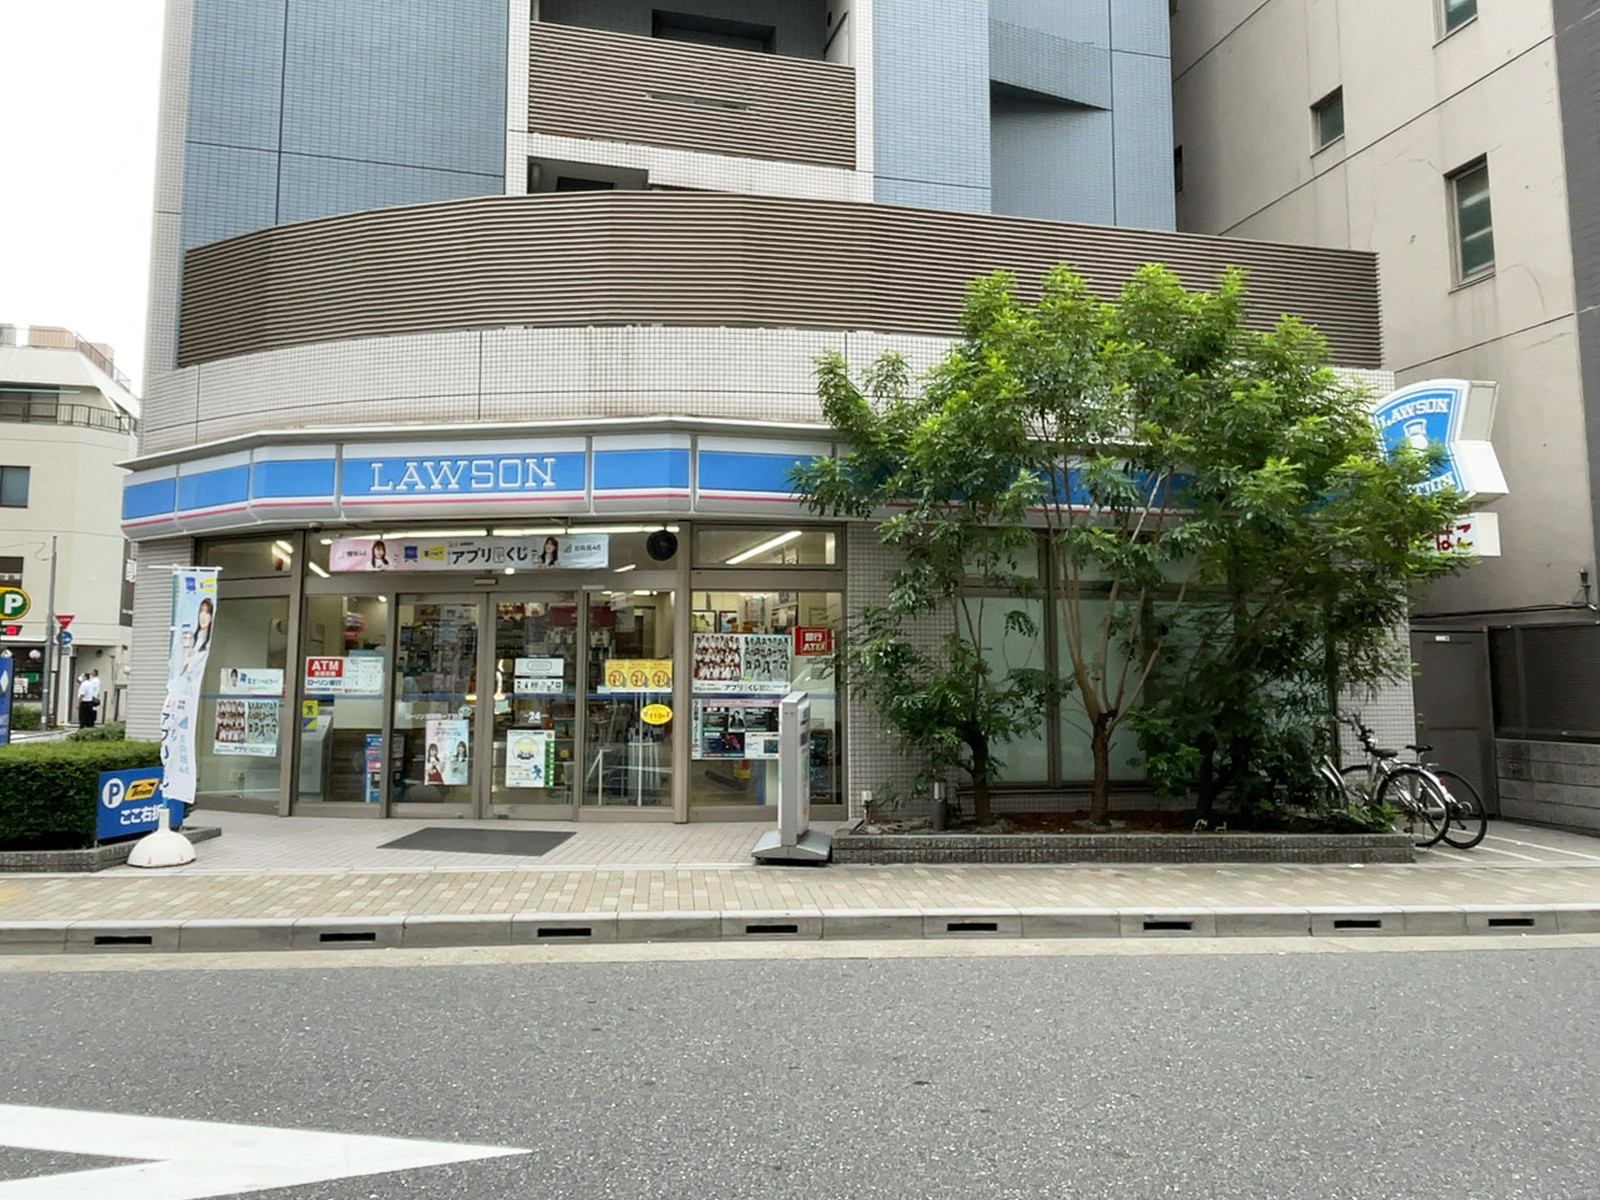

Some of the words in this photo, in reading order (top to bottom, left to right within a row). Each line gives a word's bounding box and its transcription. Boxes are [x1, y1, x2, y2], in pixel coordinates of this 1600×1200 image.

[1378, 398, 1450, 429] LAWSON
[370, 457, 556, 492] LAWSON
[4, 594, 23, 615] P
[311, 660, 339, 671] ATM
[528, 711, 542, 721] 24
[107, 783, 121, 806] P
